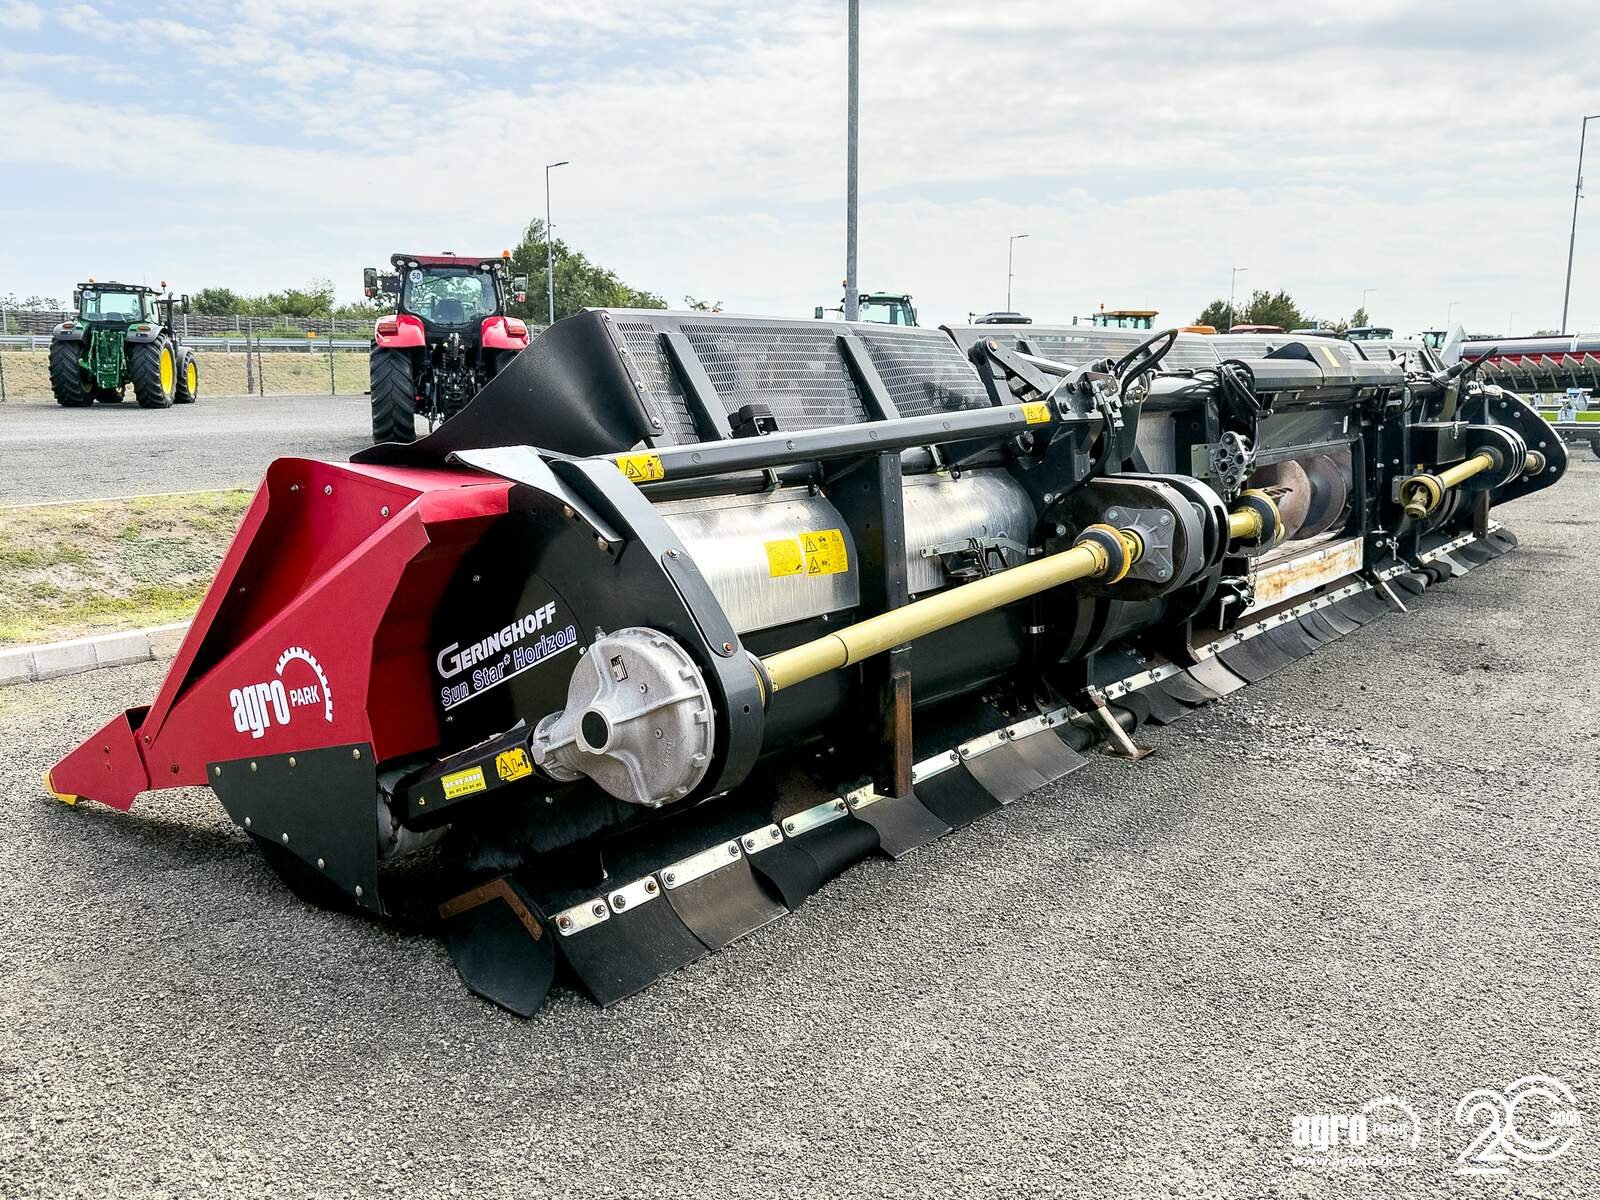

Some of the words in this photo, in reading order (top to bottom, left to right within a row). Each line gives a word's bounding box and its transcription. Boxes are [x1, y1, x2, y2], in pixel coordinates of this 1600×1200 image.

[411, 272, 421, 280] 50
[436, 600, 557, 679] GERINGHOFF
[441, 681, 470, 707] Sun
[512, 624, 577, 671] Horizon
[229, 679, 291, 739] agro
[289, 684, 321, 708] PARK
